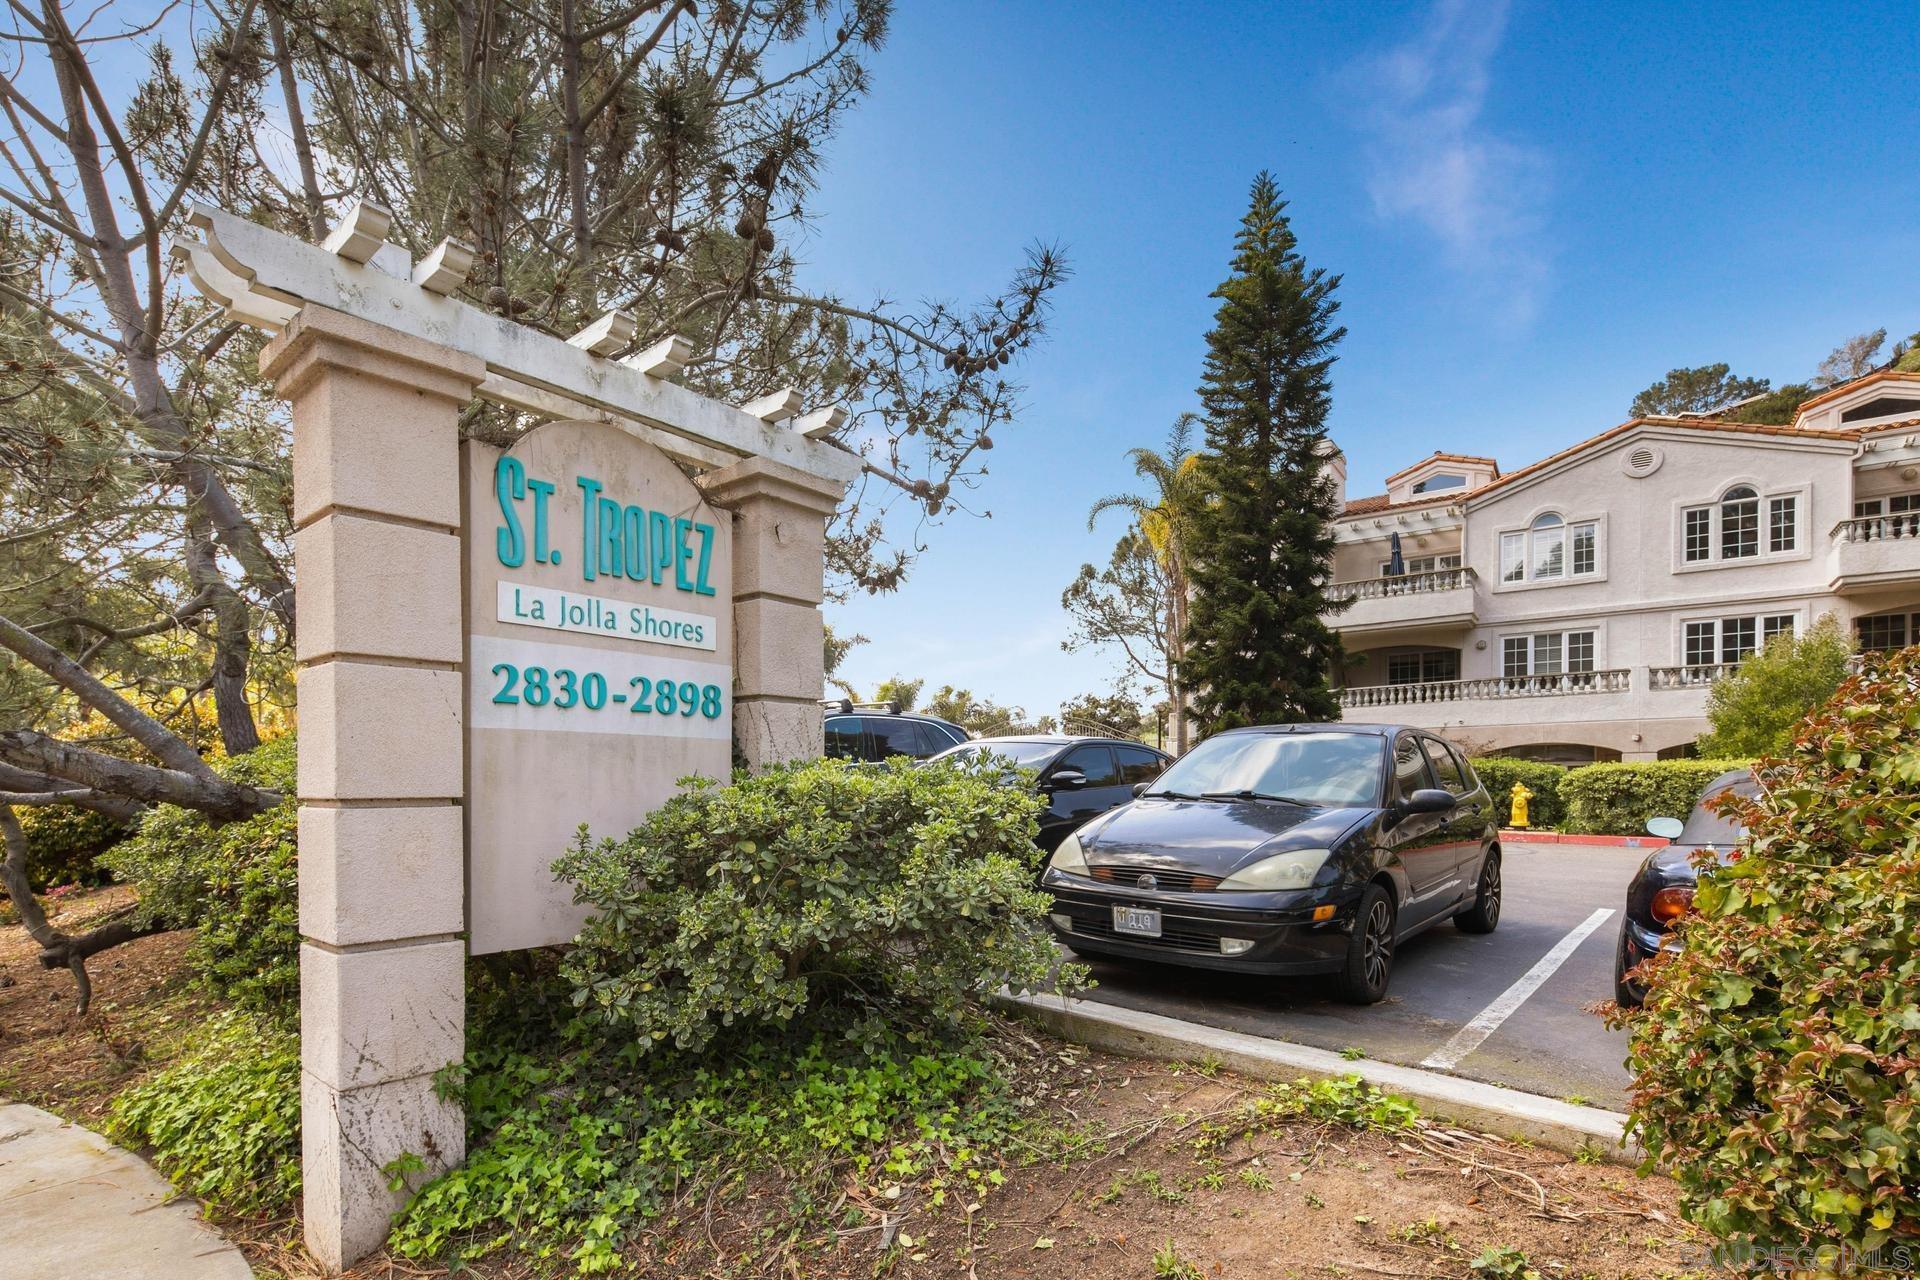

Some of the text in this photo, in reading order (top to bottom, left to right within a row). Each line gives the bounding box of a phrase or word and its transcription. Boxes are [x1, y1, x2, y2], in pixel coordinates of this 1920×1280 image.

[496, 456, 717, 597] ST. TROPEZ
[514, 588, 704, 643] La Jolla Shores
[492, 663, 723, 719] 2830-2898
